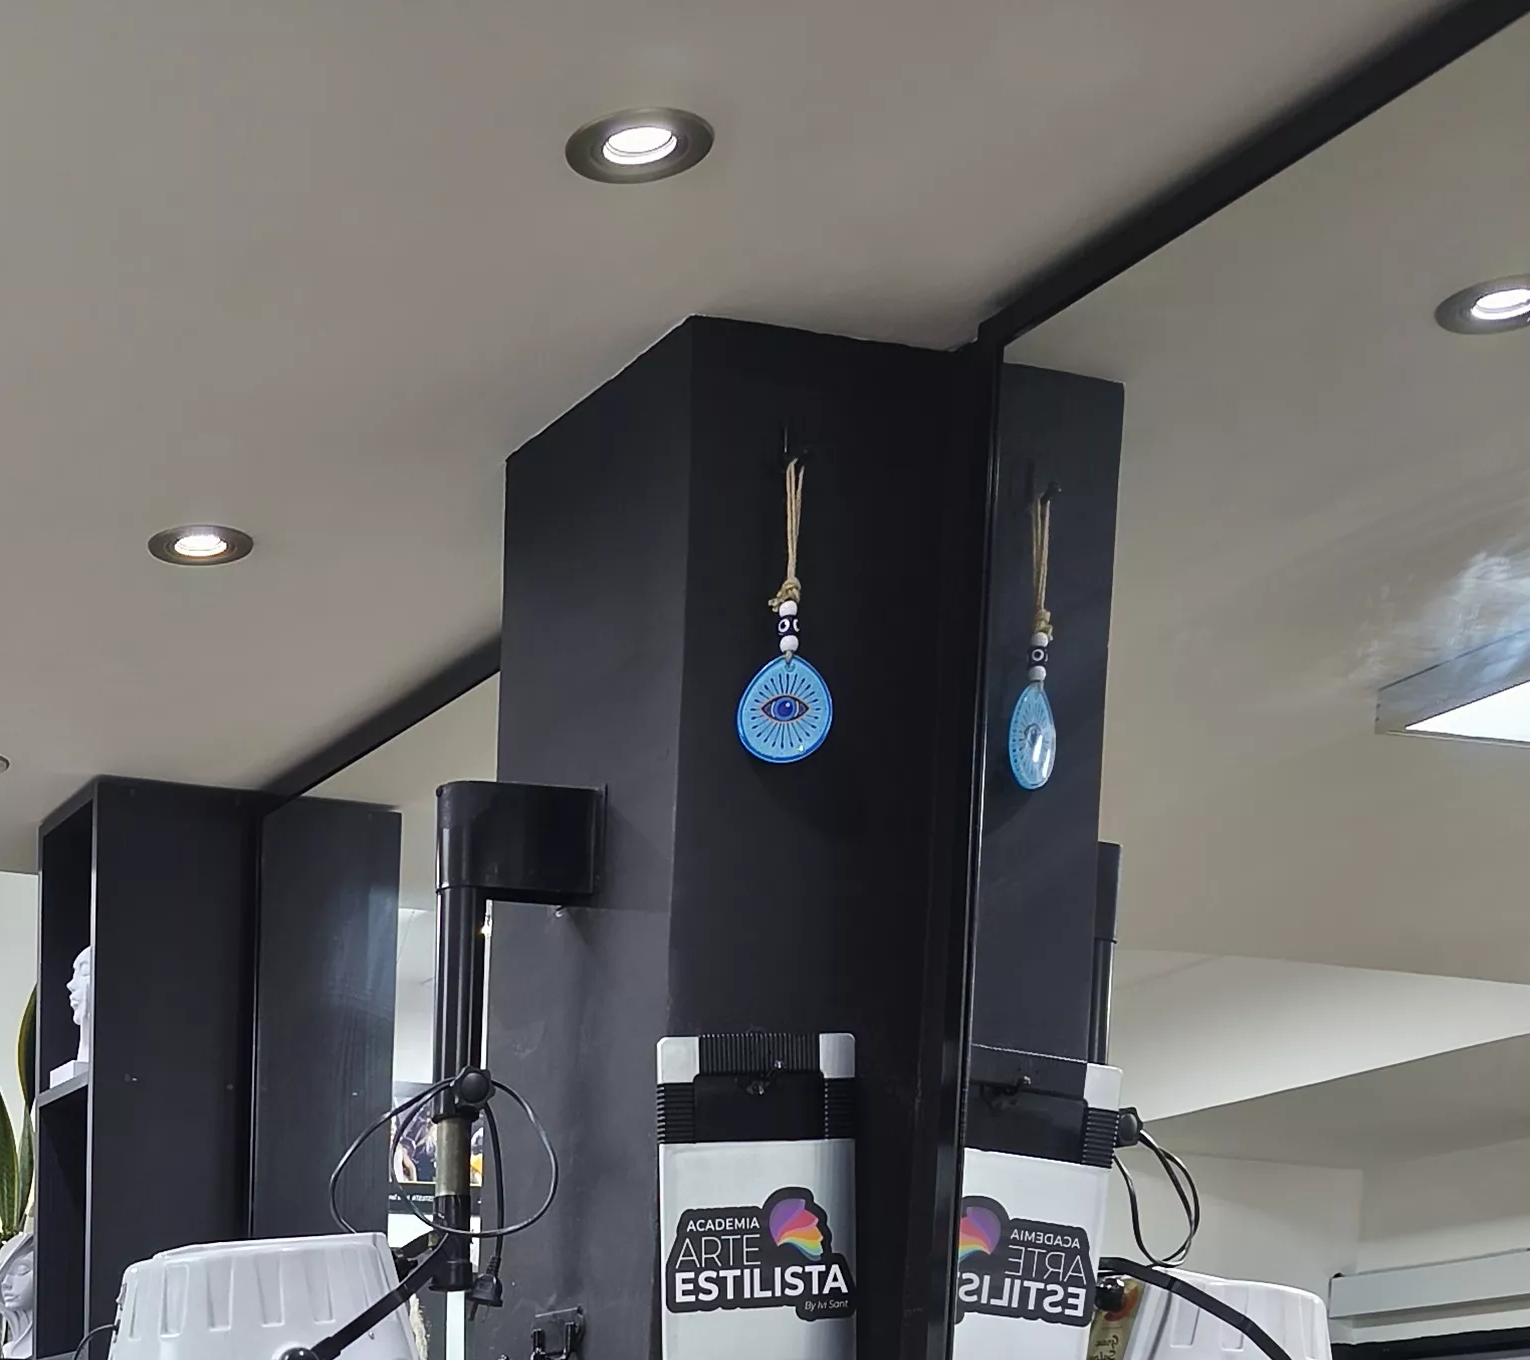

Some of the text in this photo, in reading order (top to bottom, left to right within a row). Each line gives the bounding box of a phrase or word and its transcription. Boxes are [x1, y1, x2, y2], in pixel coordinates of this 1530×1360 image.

[686, 1217, 761, 1233] ACADEMIA
[675, 1234, 761, 1269] ARTE
[675, 1263, 849, 1304] ESTILISTA
[804, 1300, 817, 1312] By
